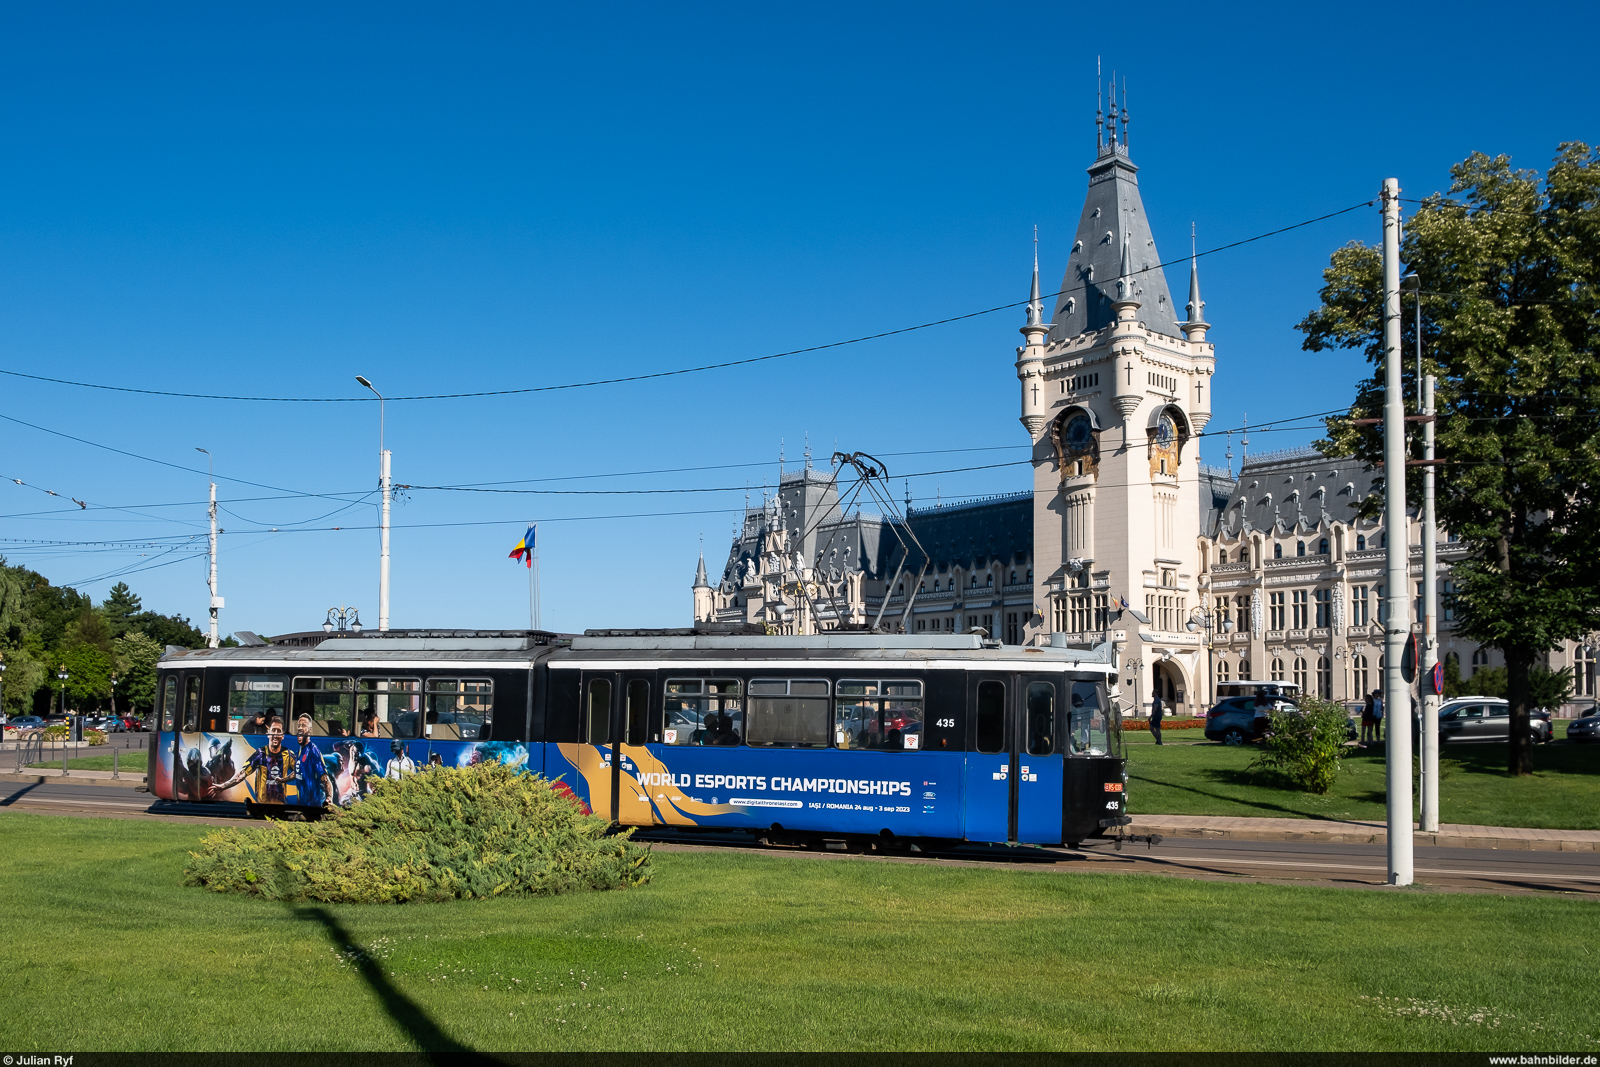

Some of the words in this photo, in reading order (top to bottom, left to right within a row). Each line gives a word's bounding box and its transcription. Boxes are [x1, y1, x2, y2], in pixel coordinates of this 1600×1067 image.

[208, 705, 221, 713] 435
[936, 718, 955, 728] 435
[636, 772, 691, 787] WORLD
[695, 774, 767, 790] ESPORTS
[770, 776, 912, 796] CHAMPIONSHIPS
[1106, 801, 1119, 810] 435
